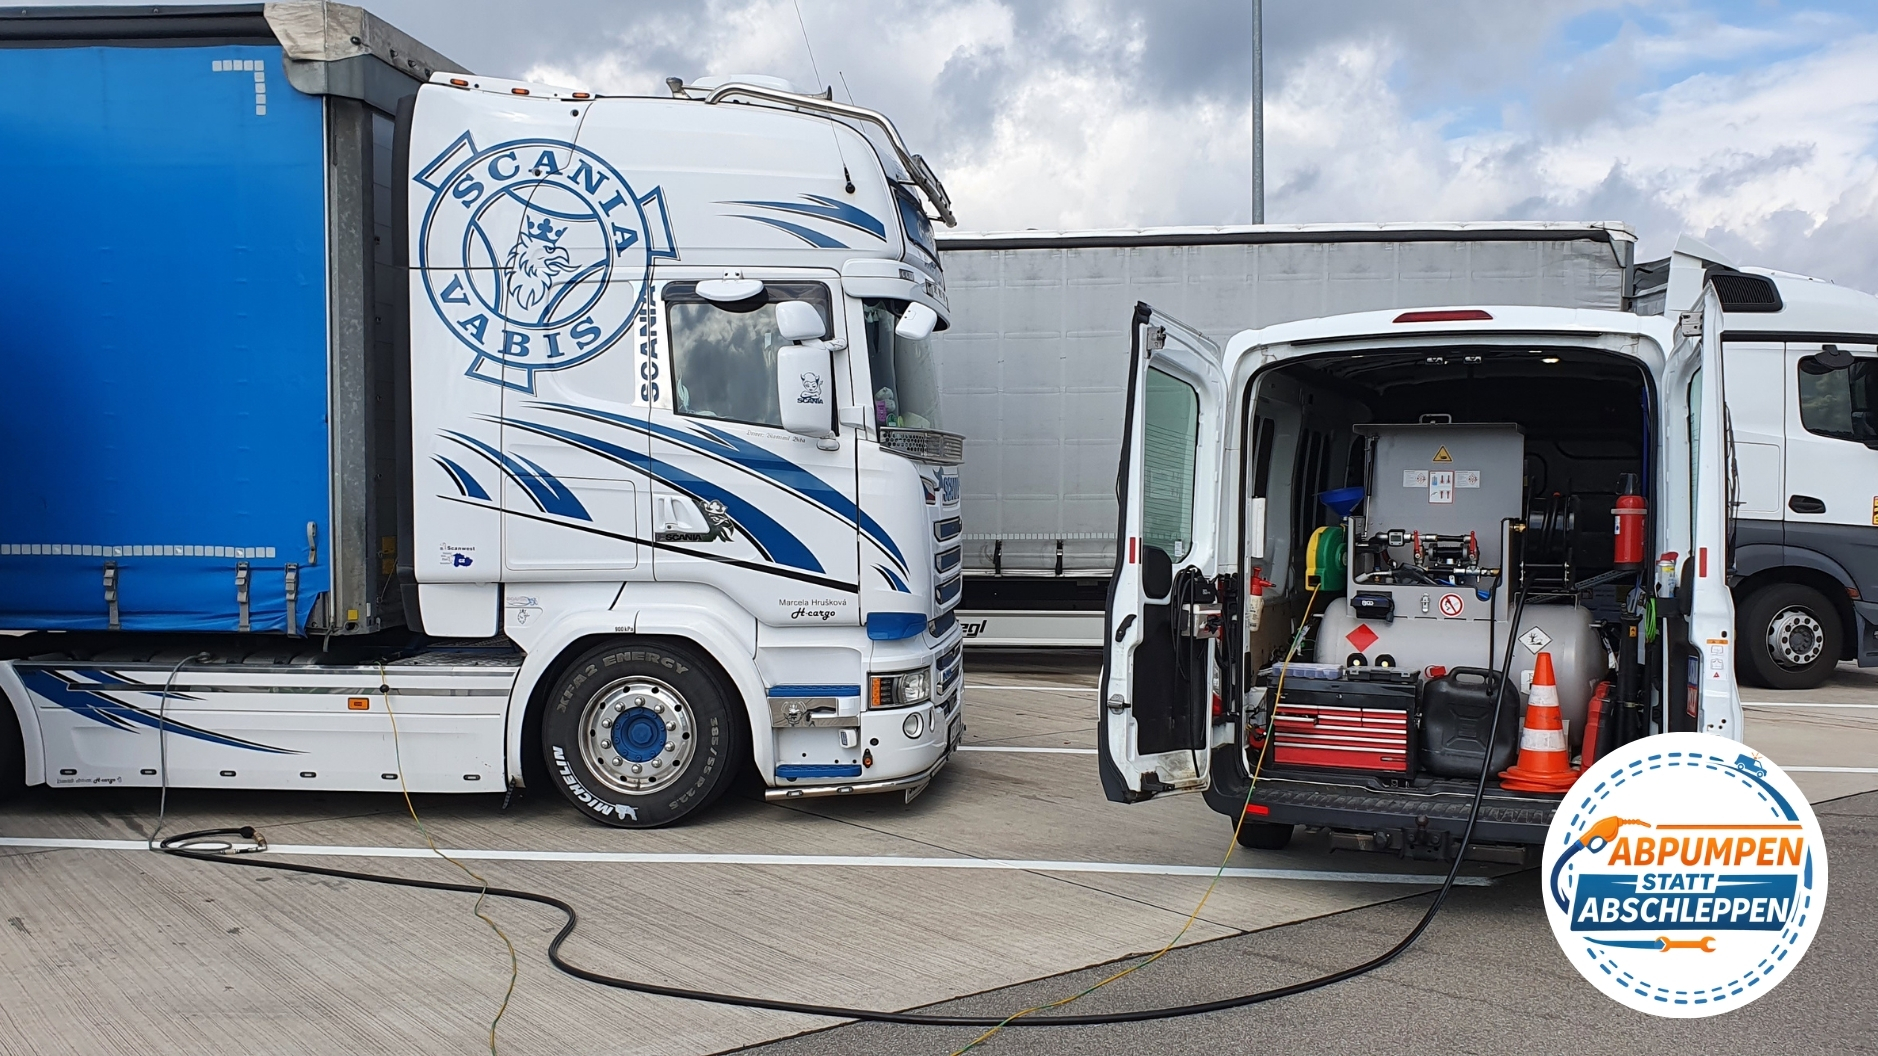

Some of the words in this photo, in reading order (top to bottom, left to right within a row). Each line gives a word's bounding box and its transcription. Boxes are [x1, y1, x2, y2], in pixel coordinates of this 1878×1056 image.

[452, 150, 639, 257] SCANIA
[440, 273, 602, 359] VABIS
[639, 284, 660, 402] SCANIA
[797, 397, 824, 405] SCANIA
[665, 533, 702, 541] SCANIA
[811, 598, 847, 606] Hrušková
[791, 607, 836, 621] H-cargo
[960, 619, 987, 637] egl
[602, 651, 690, 675] ENERGY
[552, 745, 614, 816] MICHELIN
